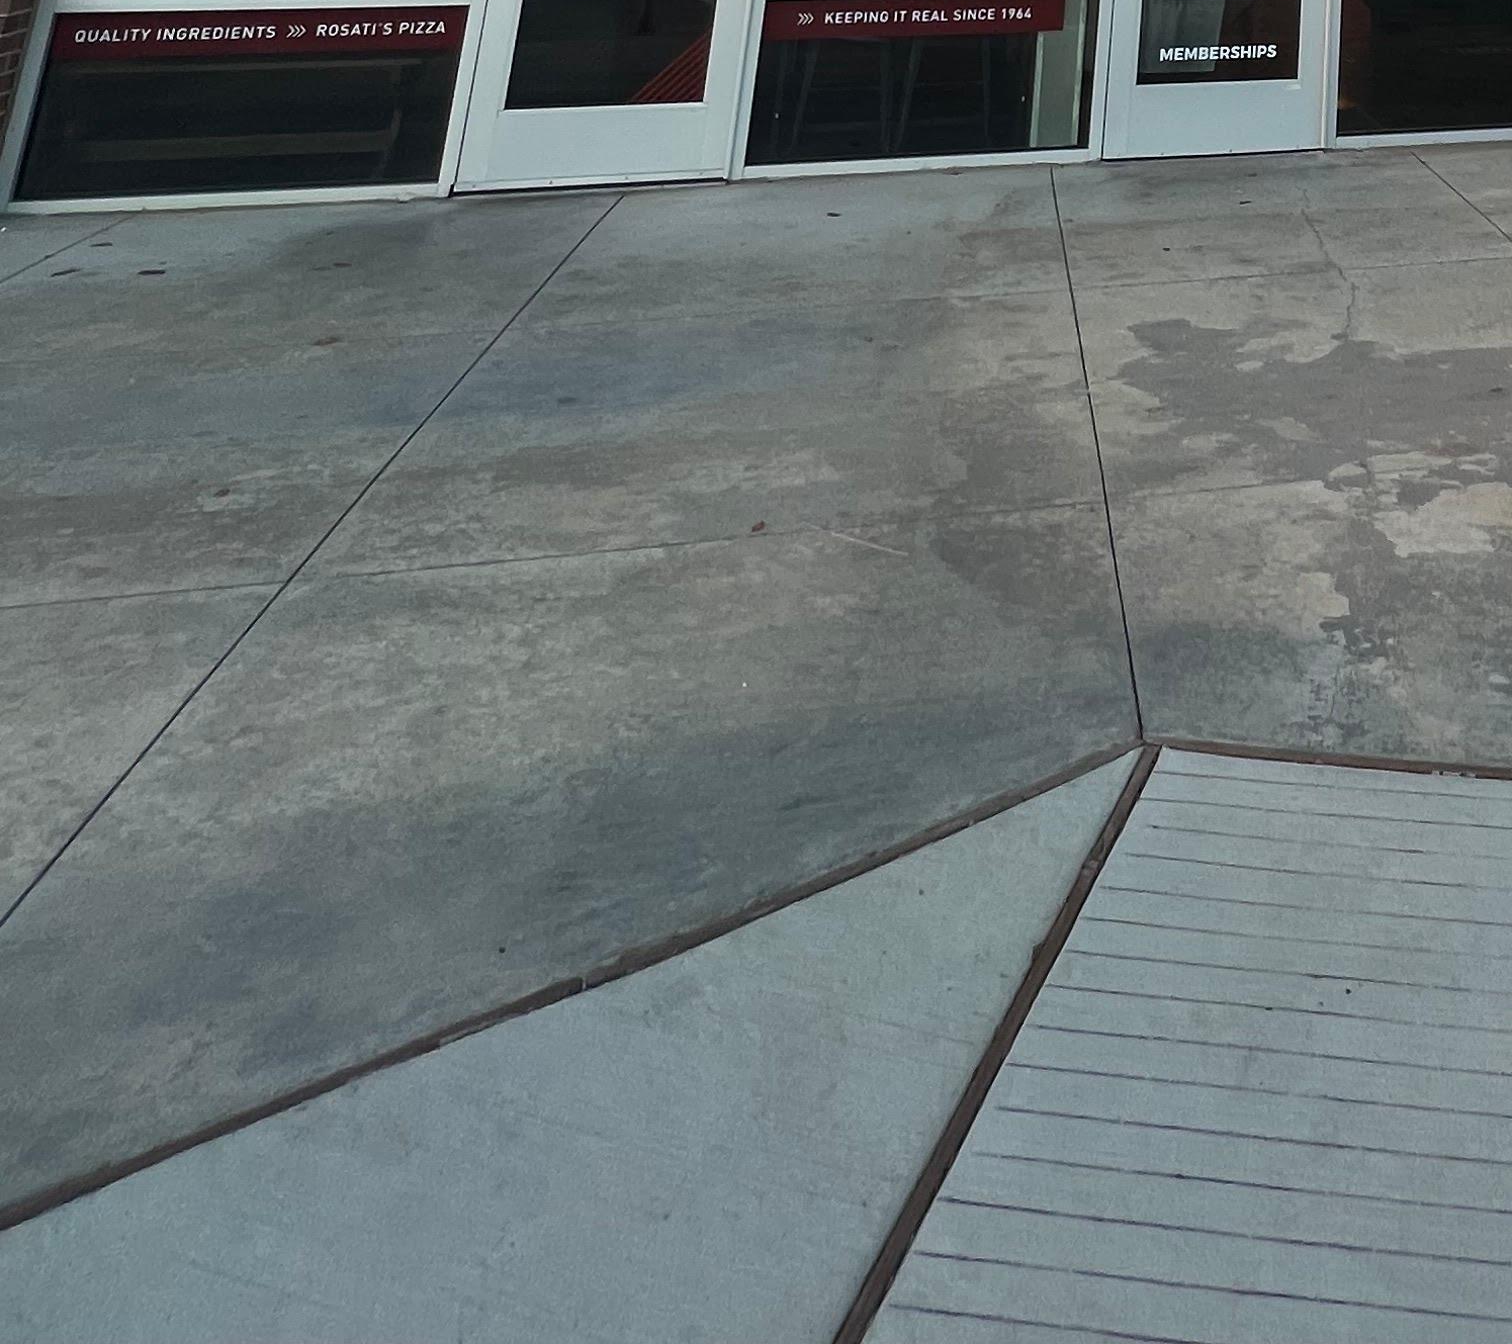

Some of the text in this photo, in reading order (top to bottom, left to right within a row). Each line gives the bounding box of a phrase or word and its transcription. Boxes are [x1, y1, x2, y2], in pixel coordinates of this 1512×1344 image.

[824, 7, 1033, 25] KEEPING IT REAL SINCE 1964
[74, 20, 447, 44] QUALITY INGREDIENTS ROSATI'S PIZZA
[1159, 44, 1278, 62] MEMBERSHIPS
